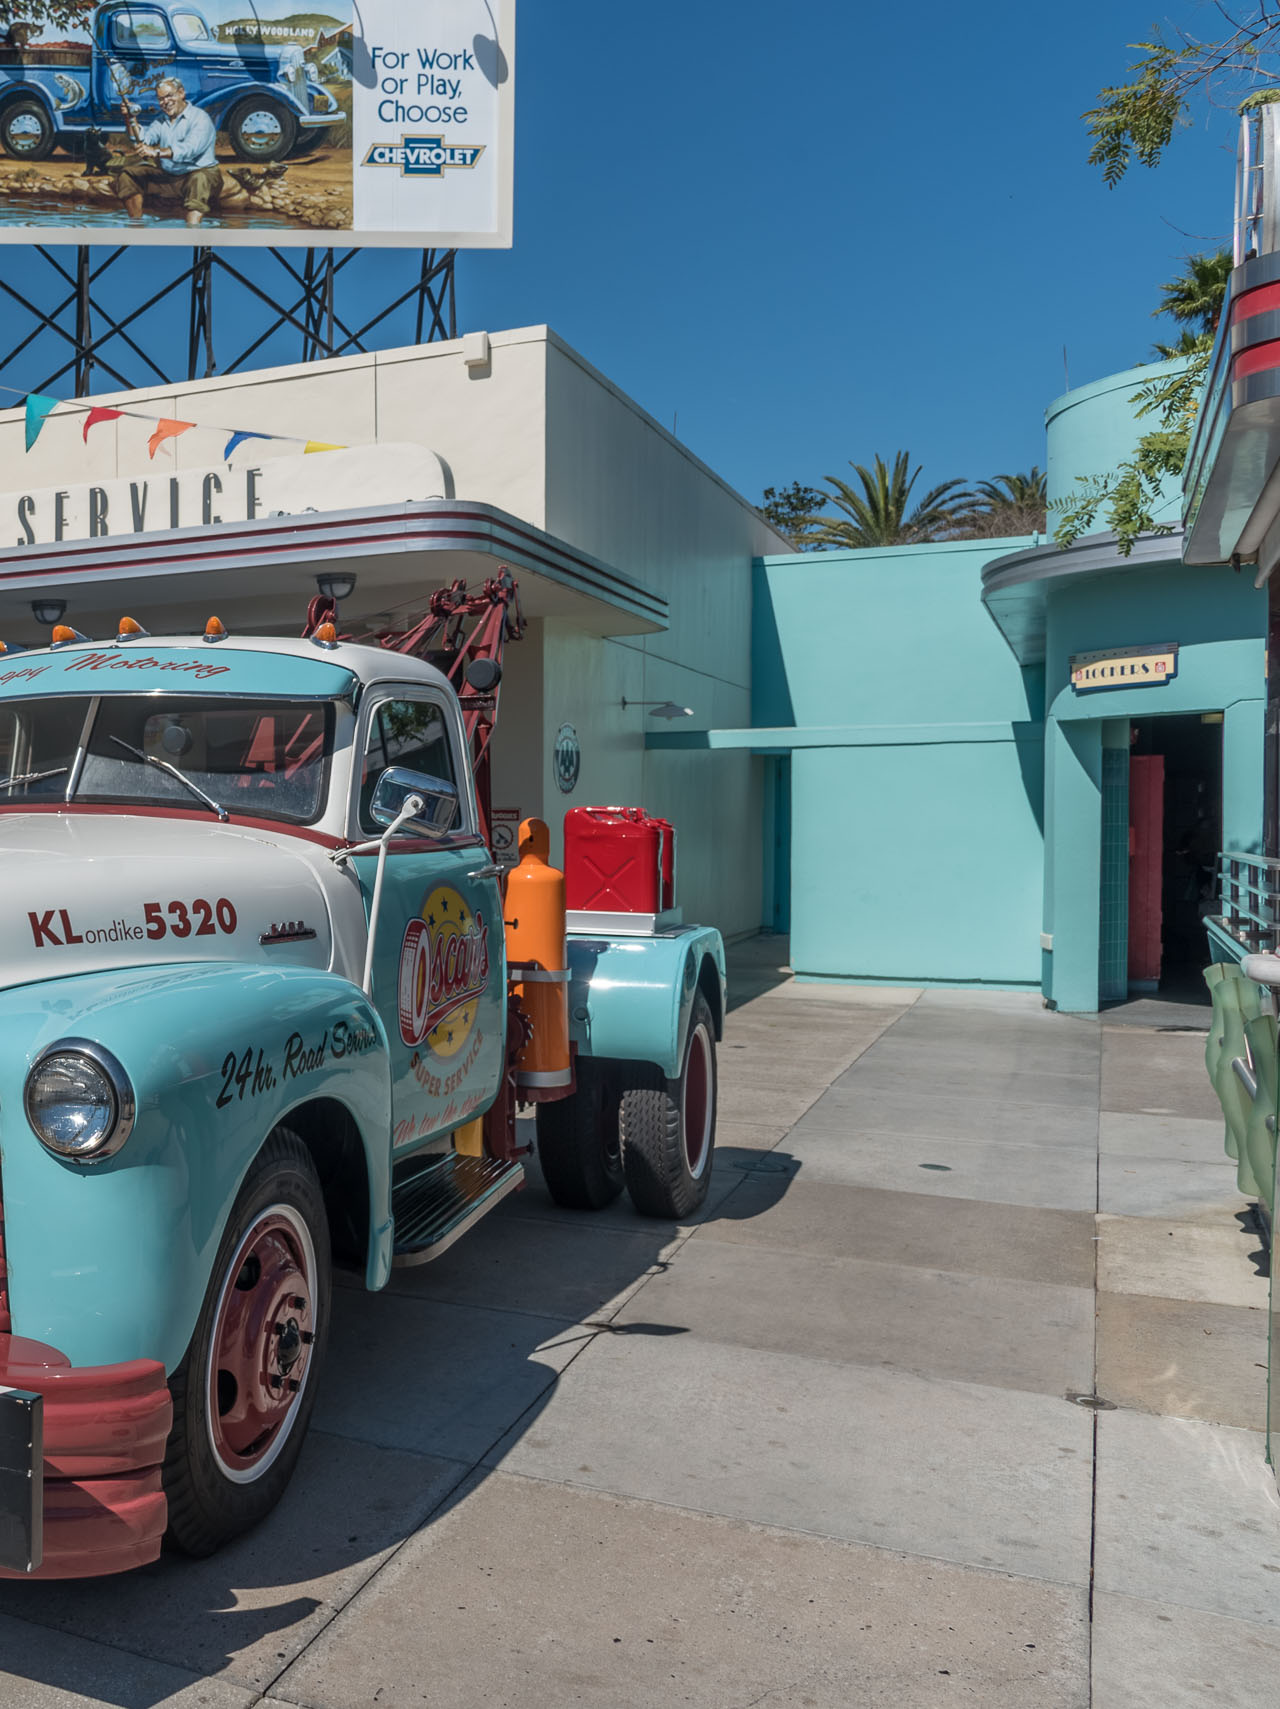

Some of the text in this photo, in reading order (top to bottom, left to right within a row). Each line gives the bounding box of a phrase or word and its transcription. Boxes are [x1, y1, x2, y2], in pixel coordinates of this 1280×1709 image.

[371, 47, 475, 70] For Work
[381, 73, 463, 100] or Play,
[377, 100, 468, 124] Choose
[373, 147, 474, 165] CHEVROLET
[16, 467, 263, 547] SERVICE
[63, 652, 232, 680] Motoring
[1084, 663, 1150, 680] LOCKERS
[143, 897, 238, 941] 5320
[397, 911, 489, 1048] Oscar's
[282, 1031, 329, 1081] Road
[410, 1028, 483, 1097] SUPER SERVICE
